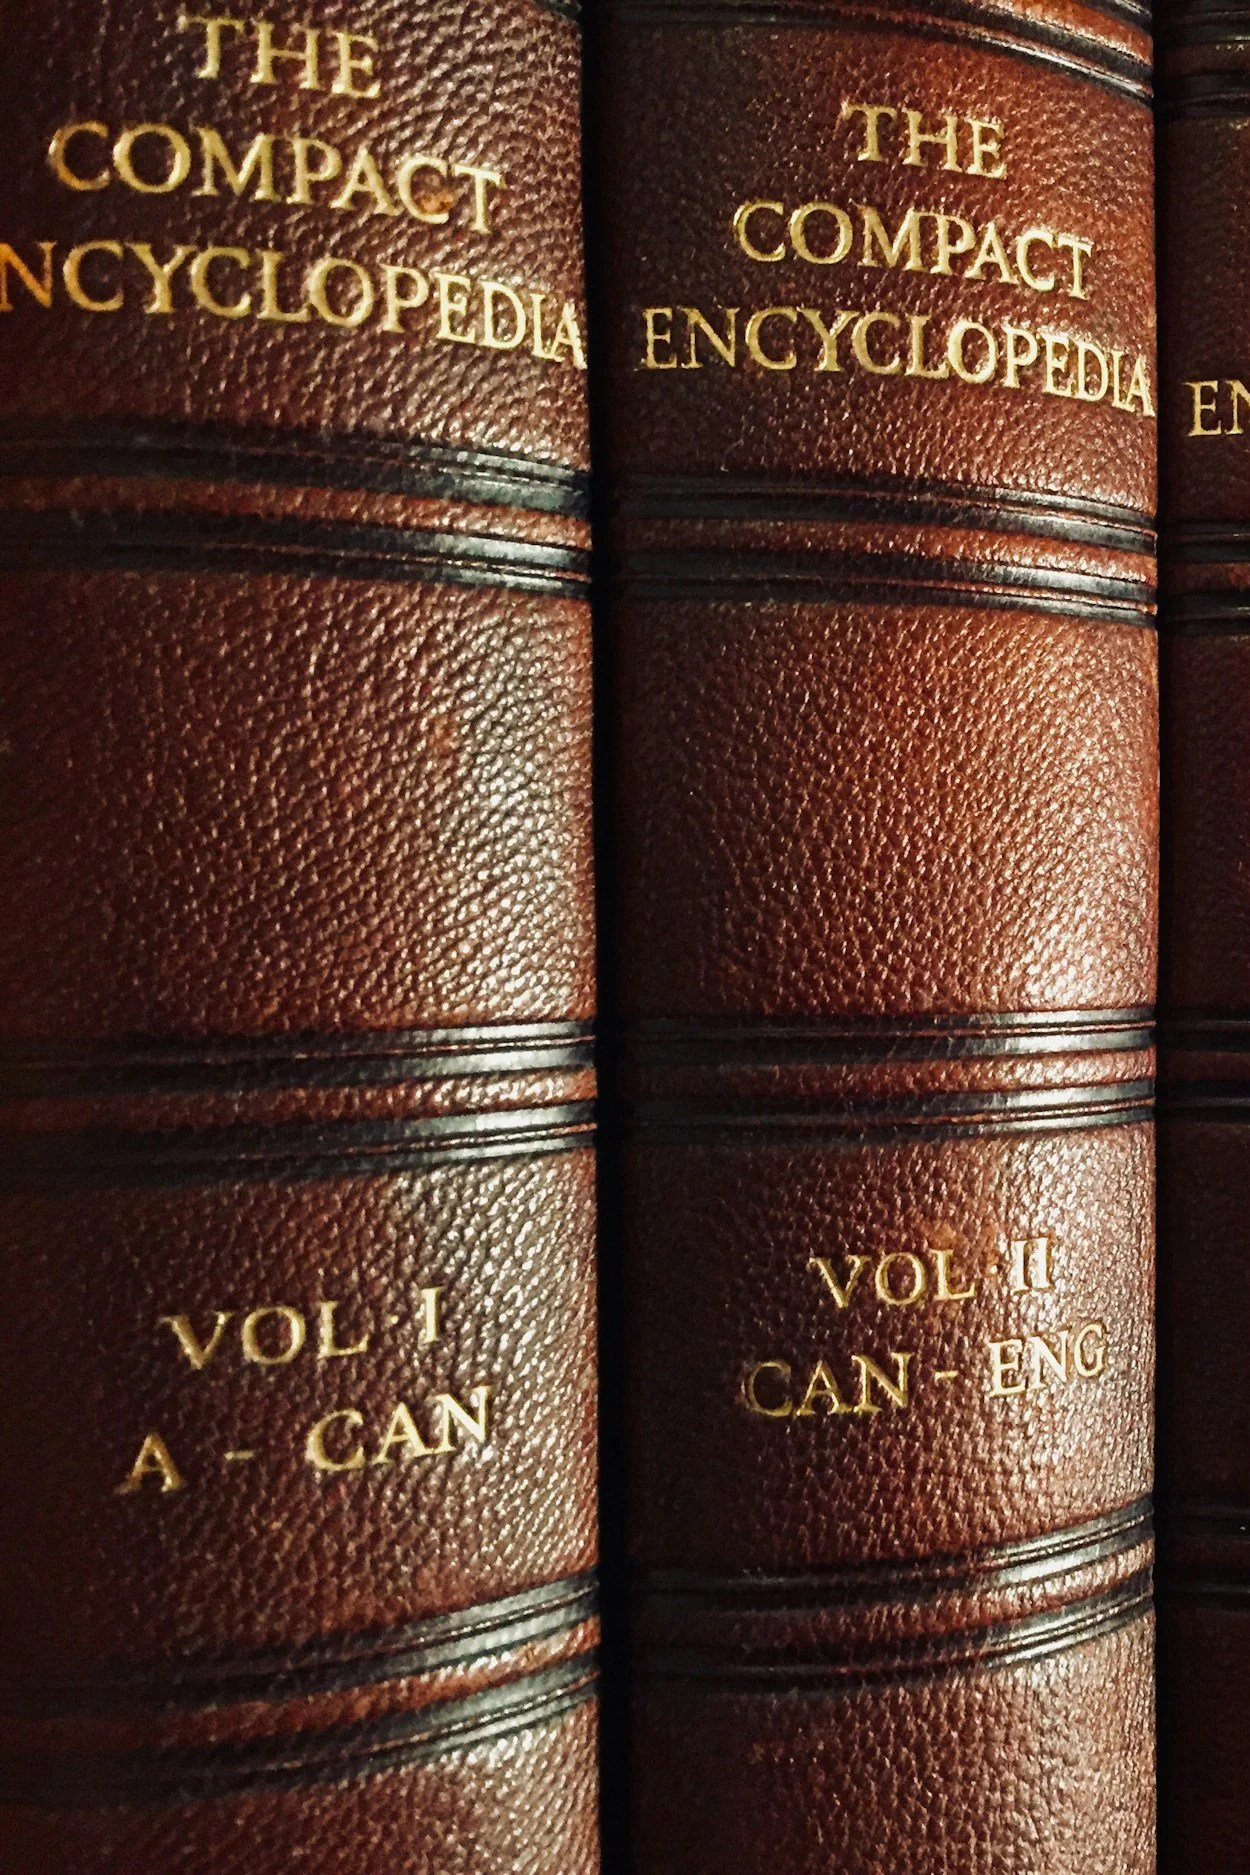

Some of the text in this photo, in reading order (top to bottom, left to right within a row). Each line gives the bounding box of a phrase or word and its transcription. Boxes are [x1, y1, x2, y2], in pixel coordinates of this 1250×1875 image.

[181, 15, 382, 99] THE
[48, 120, 506, 234] COMPACT
[842, 101, 1008, 179] THE
[733, 201, 1094, 300] COMPACT
[640, 305, 1155, 417] ENCYCLOPEDIA
[808, 1248, 976, 1309] VOL
[1011, 1237, 1054, 1295] II
[164, 1300, 369, 1370] VOL
[419, 1287, 446, 1344] I
[745, 1351, 914, 1418] CAN
[988, 1323, 1106, 1397] ENG
[115, 1432, 186, 1494] A
[307, 1385, 493, 1472] CAN
